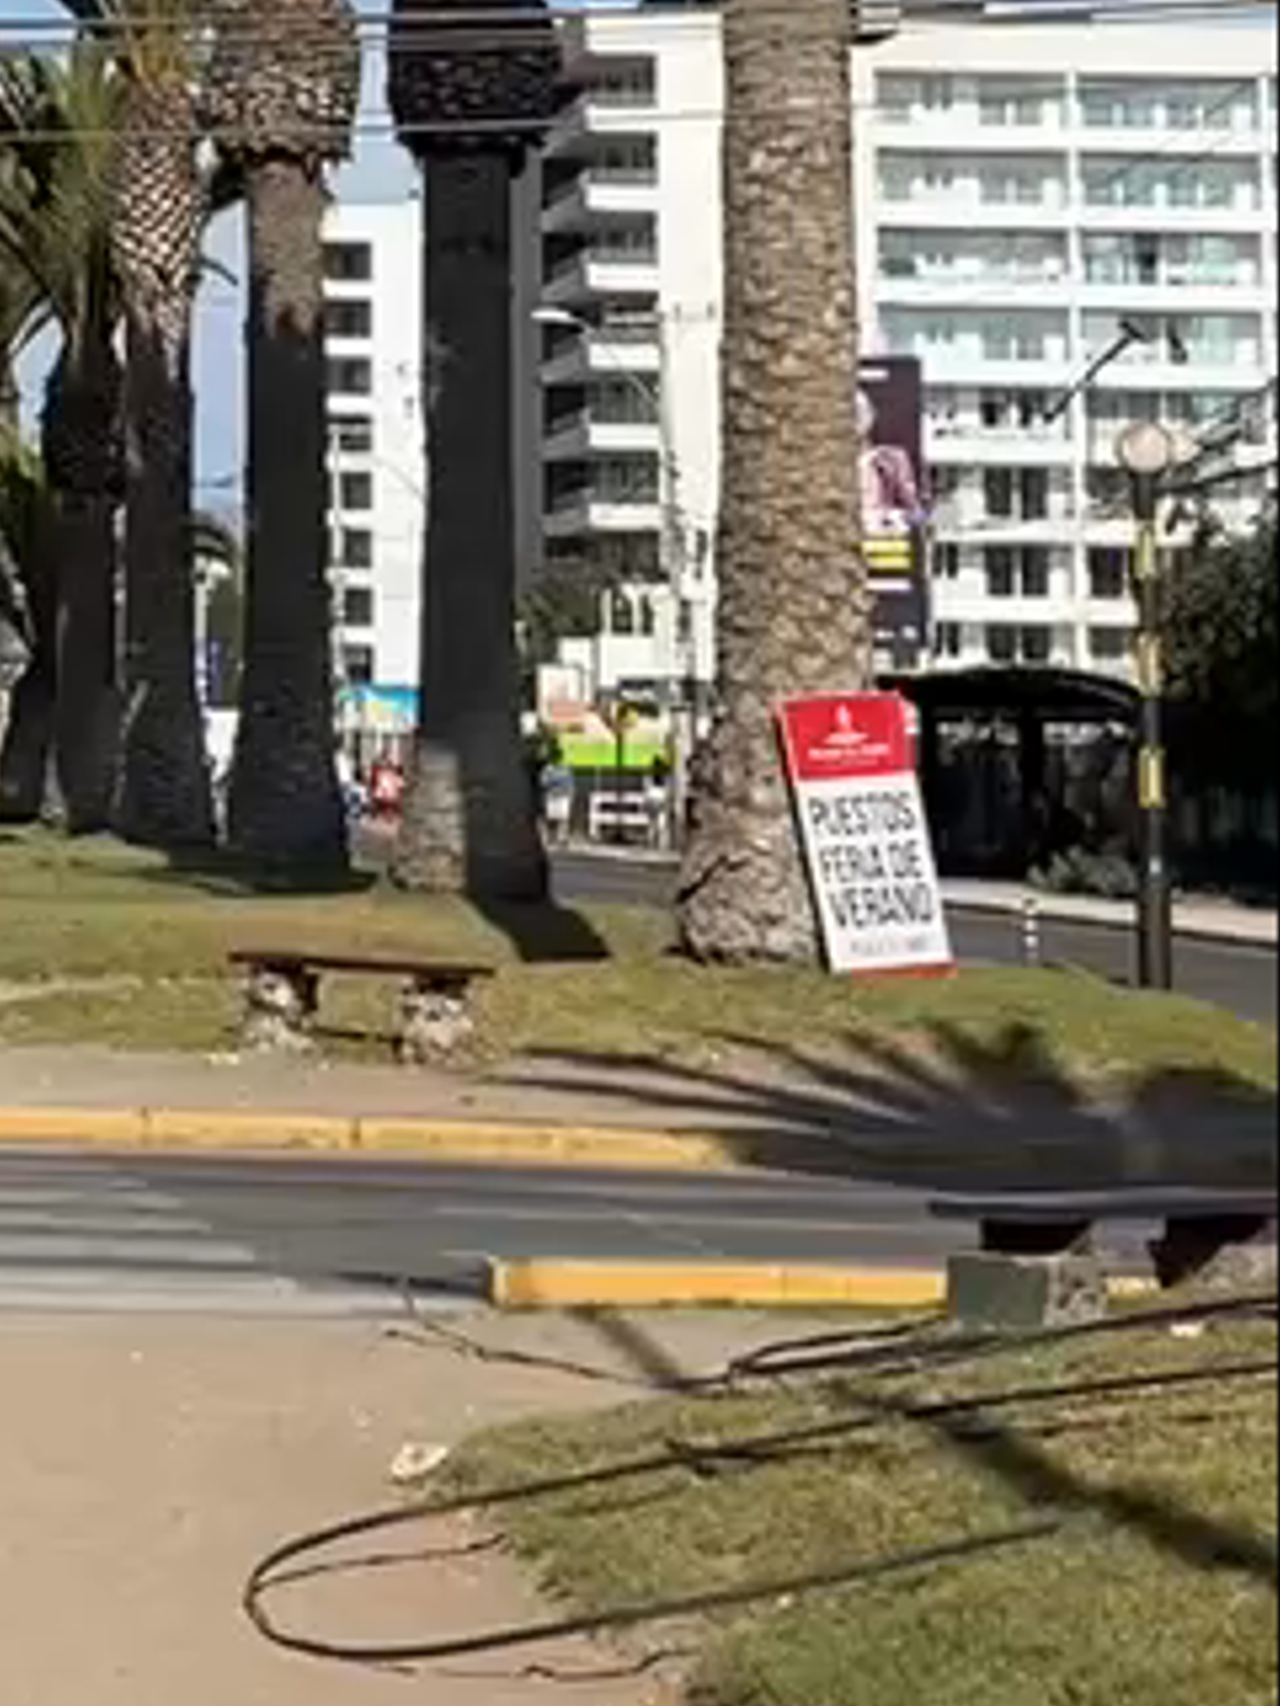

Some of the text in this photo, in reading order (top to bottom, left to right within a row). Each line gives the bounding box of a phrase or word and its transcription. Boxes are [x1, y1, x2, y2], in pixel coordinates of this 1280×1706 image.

[808, 791, 916, 836] PUESTOS
[819, 839, 923, 883] FERIA DE
[827, 883, 934, 929] VERANO
